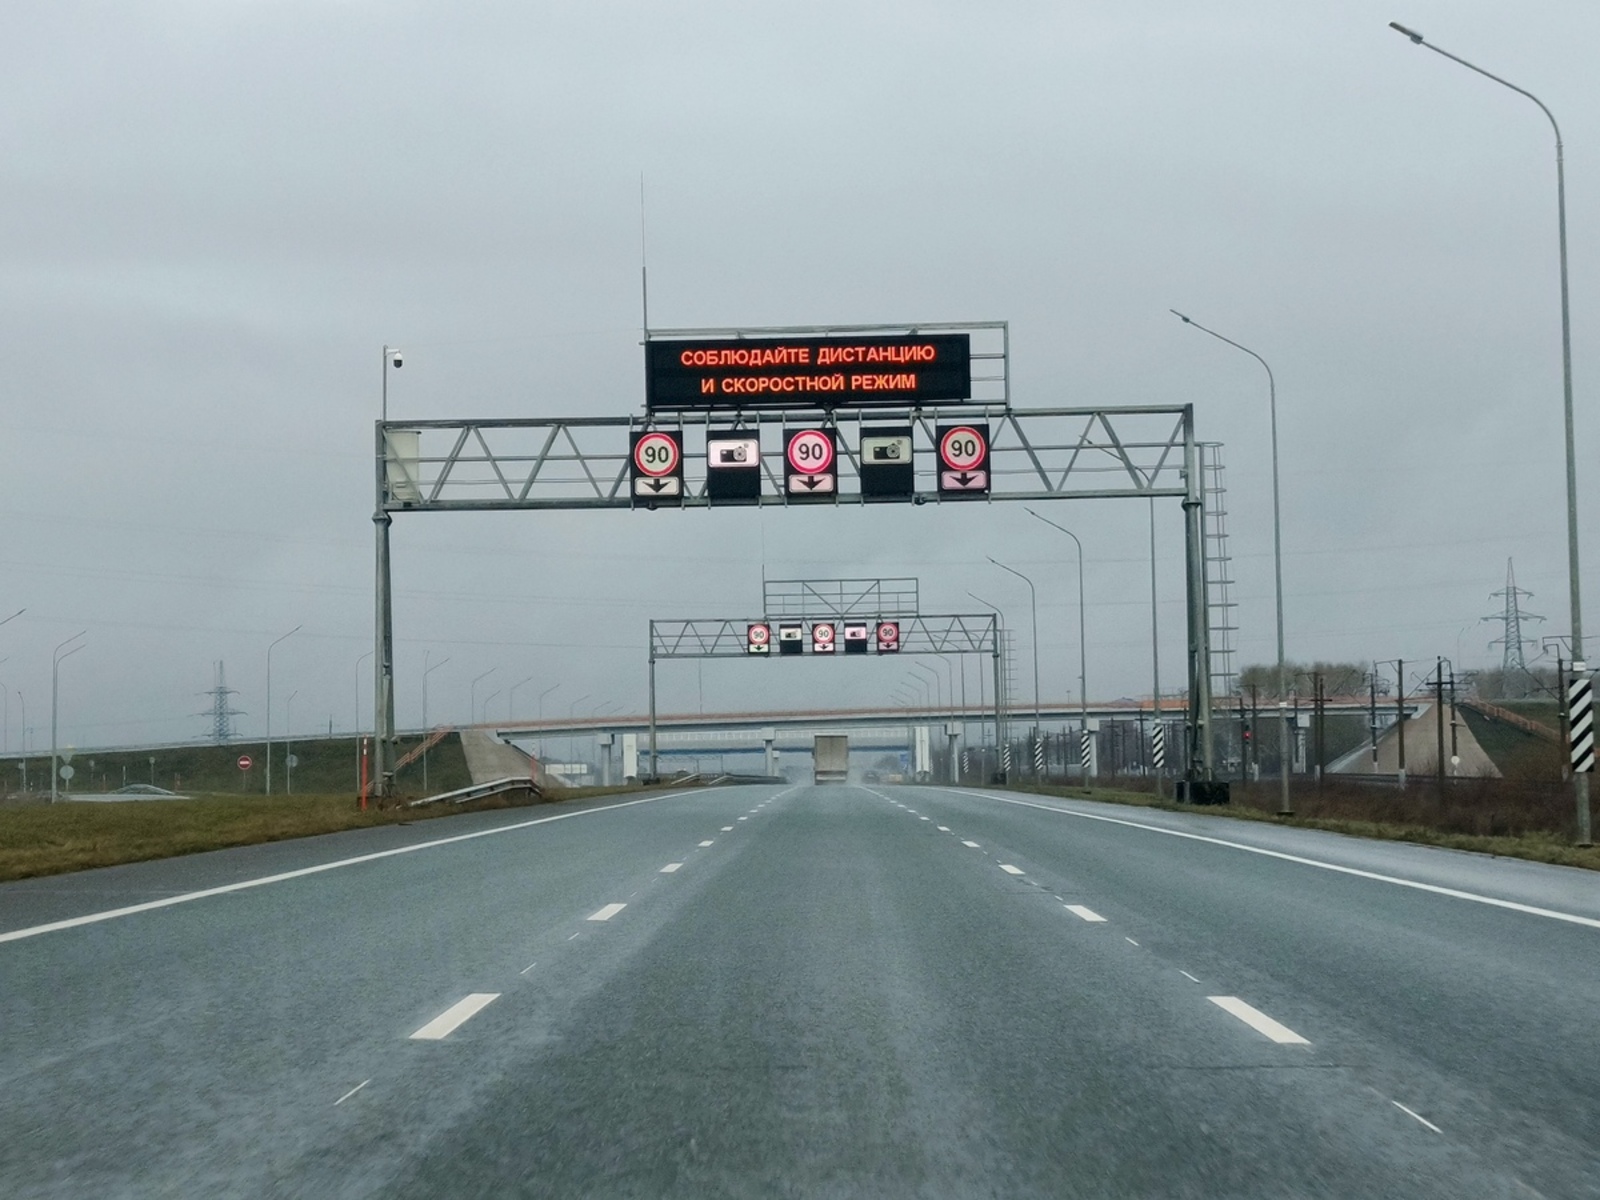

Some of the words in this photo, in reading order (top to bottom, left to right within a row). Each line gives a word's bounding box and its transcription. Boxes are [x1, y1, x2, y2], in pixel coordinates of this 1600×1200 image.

[681, 347, 810, 366] СОБЛЮДАЙТЕ
[817, 346, 935, 364] ДИСТАНЦИЮ
[701, 379, 715, 393] И
[721, 373, 845, 392] СКОРОСТНОЙ
[851, 374, 916, 390] РЕЖИМ
[644, 446, 669, 464] 90
[798, 443, 824, 461] 90
[951, 439, 977, 458] 90
[818, 629, 829, 638] 90
[882, 628, 894, 637] 90
